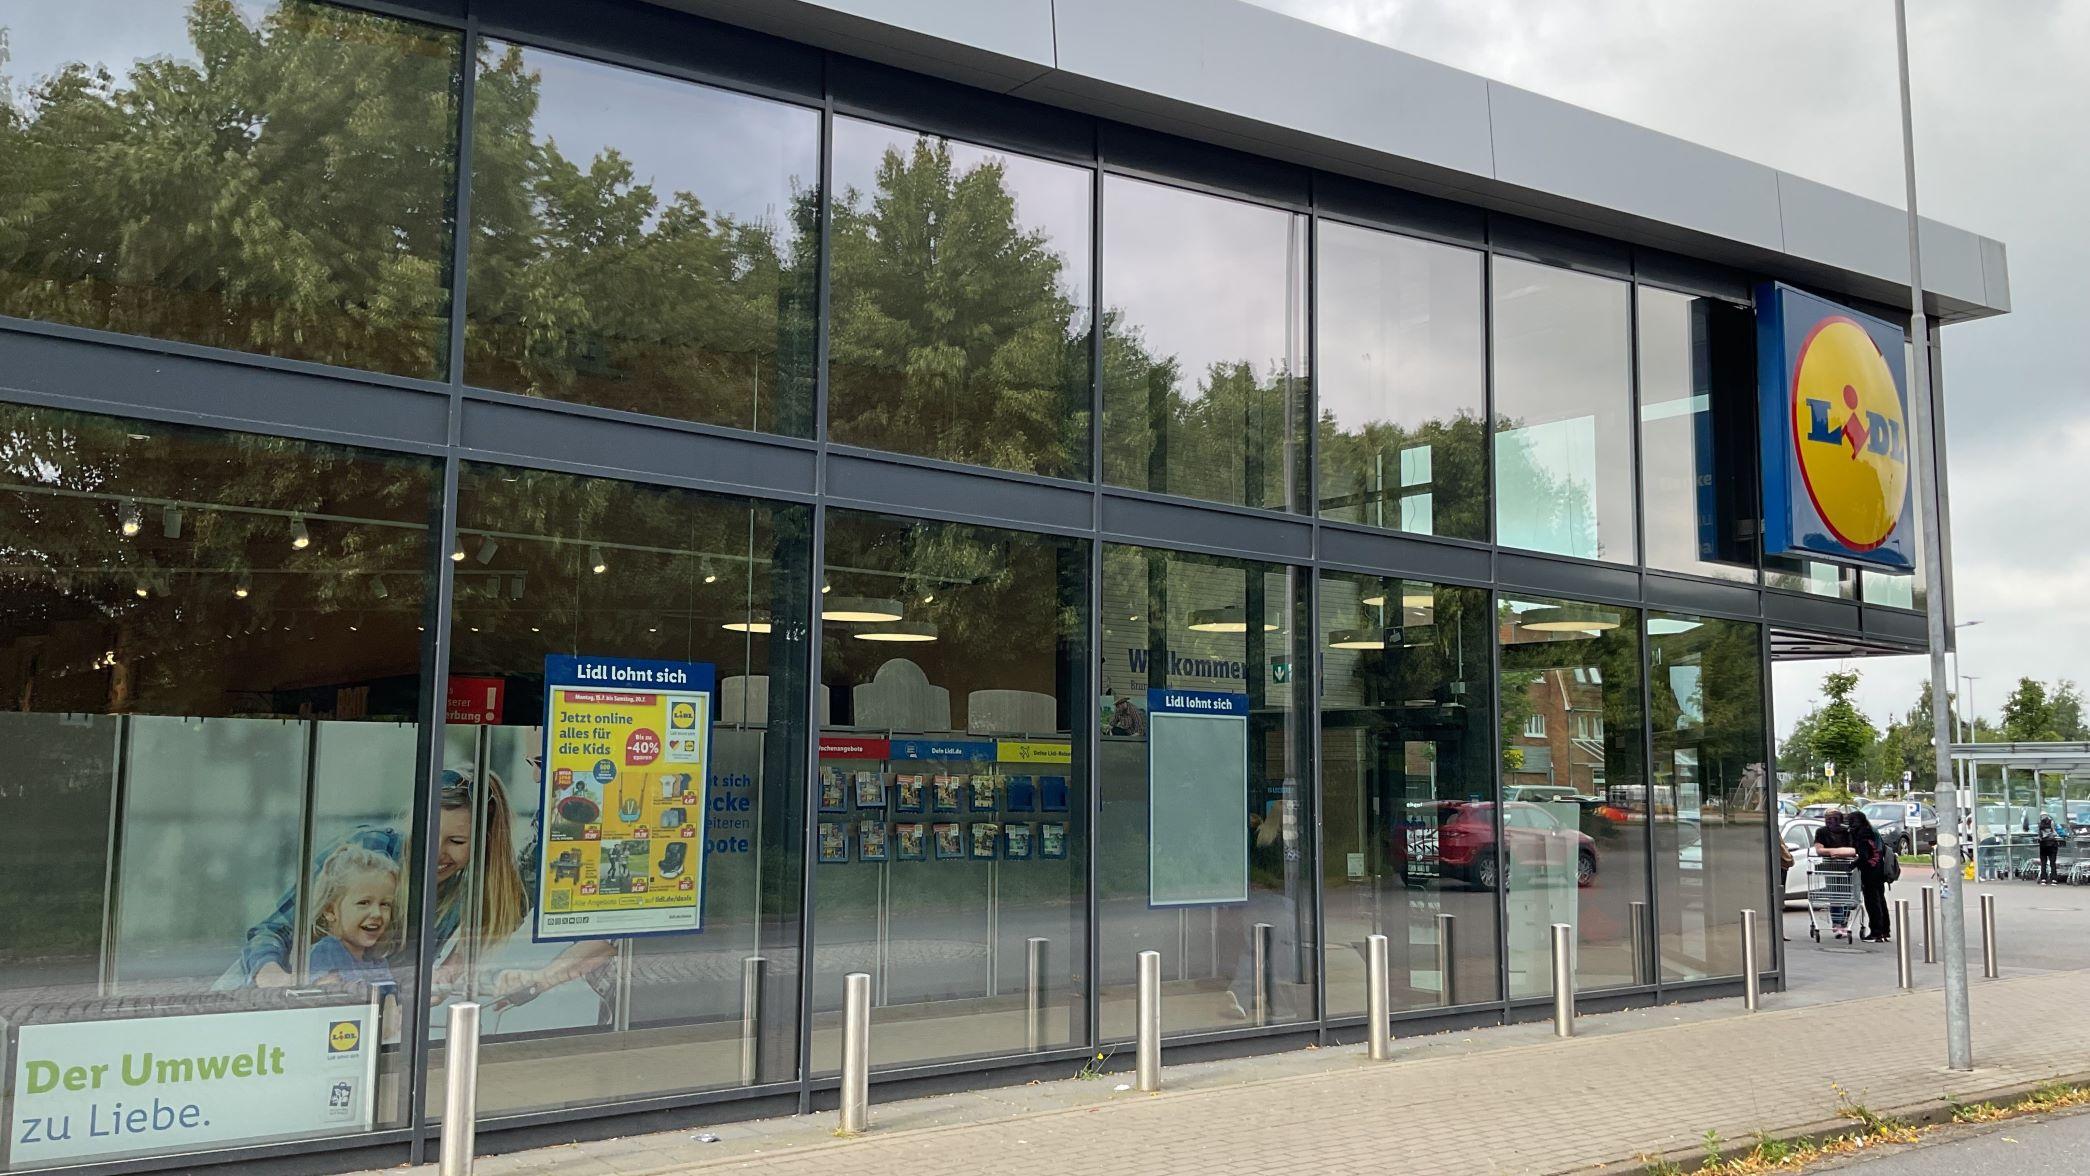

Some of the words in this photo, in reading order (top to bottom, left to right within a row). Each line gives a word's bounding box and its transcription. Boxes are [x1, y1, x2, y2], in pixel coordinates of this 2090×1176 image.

[577, 663, 607, 680] Lidl
[611, 665, 653, 682] lohnt
[656, 667, 687, 684] sich
[1165, 695, 1184, 708] Lidl
[1186, 695, 1212, 709] lohnt
[1213, 697, 1233, 710] sich
[446, 710, 481, 723] erbung
[560, 711, 591, 724] Jetzt
[594, 712, 633, 725] online
[559, 727, 589, 739] alles
[592, 727, 611, 740] für
[559, 743, 580, 755] die
[583, 743, 611, 755] Kids
[627, 741, 660, 754] -40%
[707, 816, 750, 829] eiteren
[25, 1059, 109, 1095] Der
[121, 1043, 286, 1088] Umwelt
[19, 1114, 72, 1144] zu
[89, 1097, 211, 1137] Liebe.
